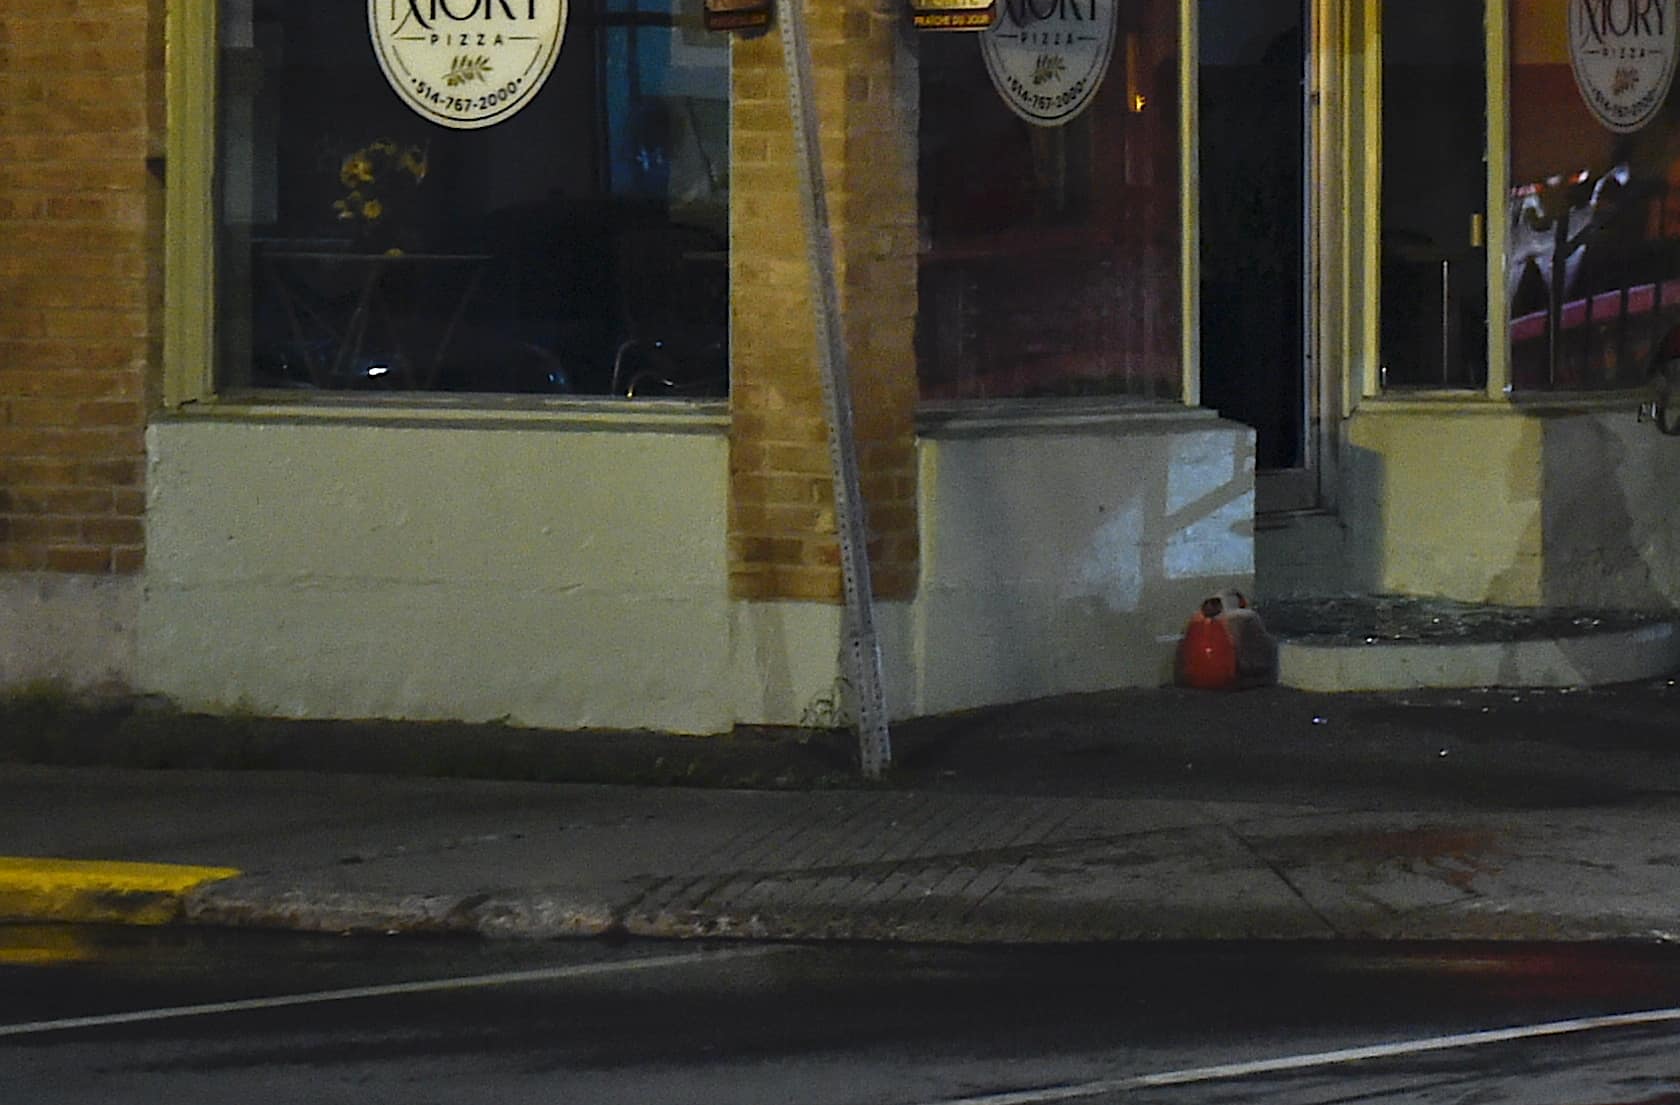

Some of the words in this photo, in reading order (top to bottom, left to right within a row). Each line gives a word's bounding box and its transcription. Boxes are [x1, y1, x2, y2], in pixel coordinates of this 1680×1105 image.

[430, 33, 504, 46] PIZZA
[1020, 31, 1074, 45] PIZZA
[415, 80, 518, 113] 514-767-2000
